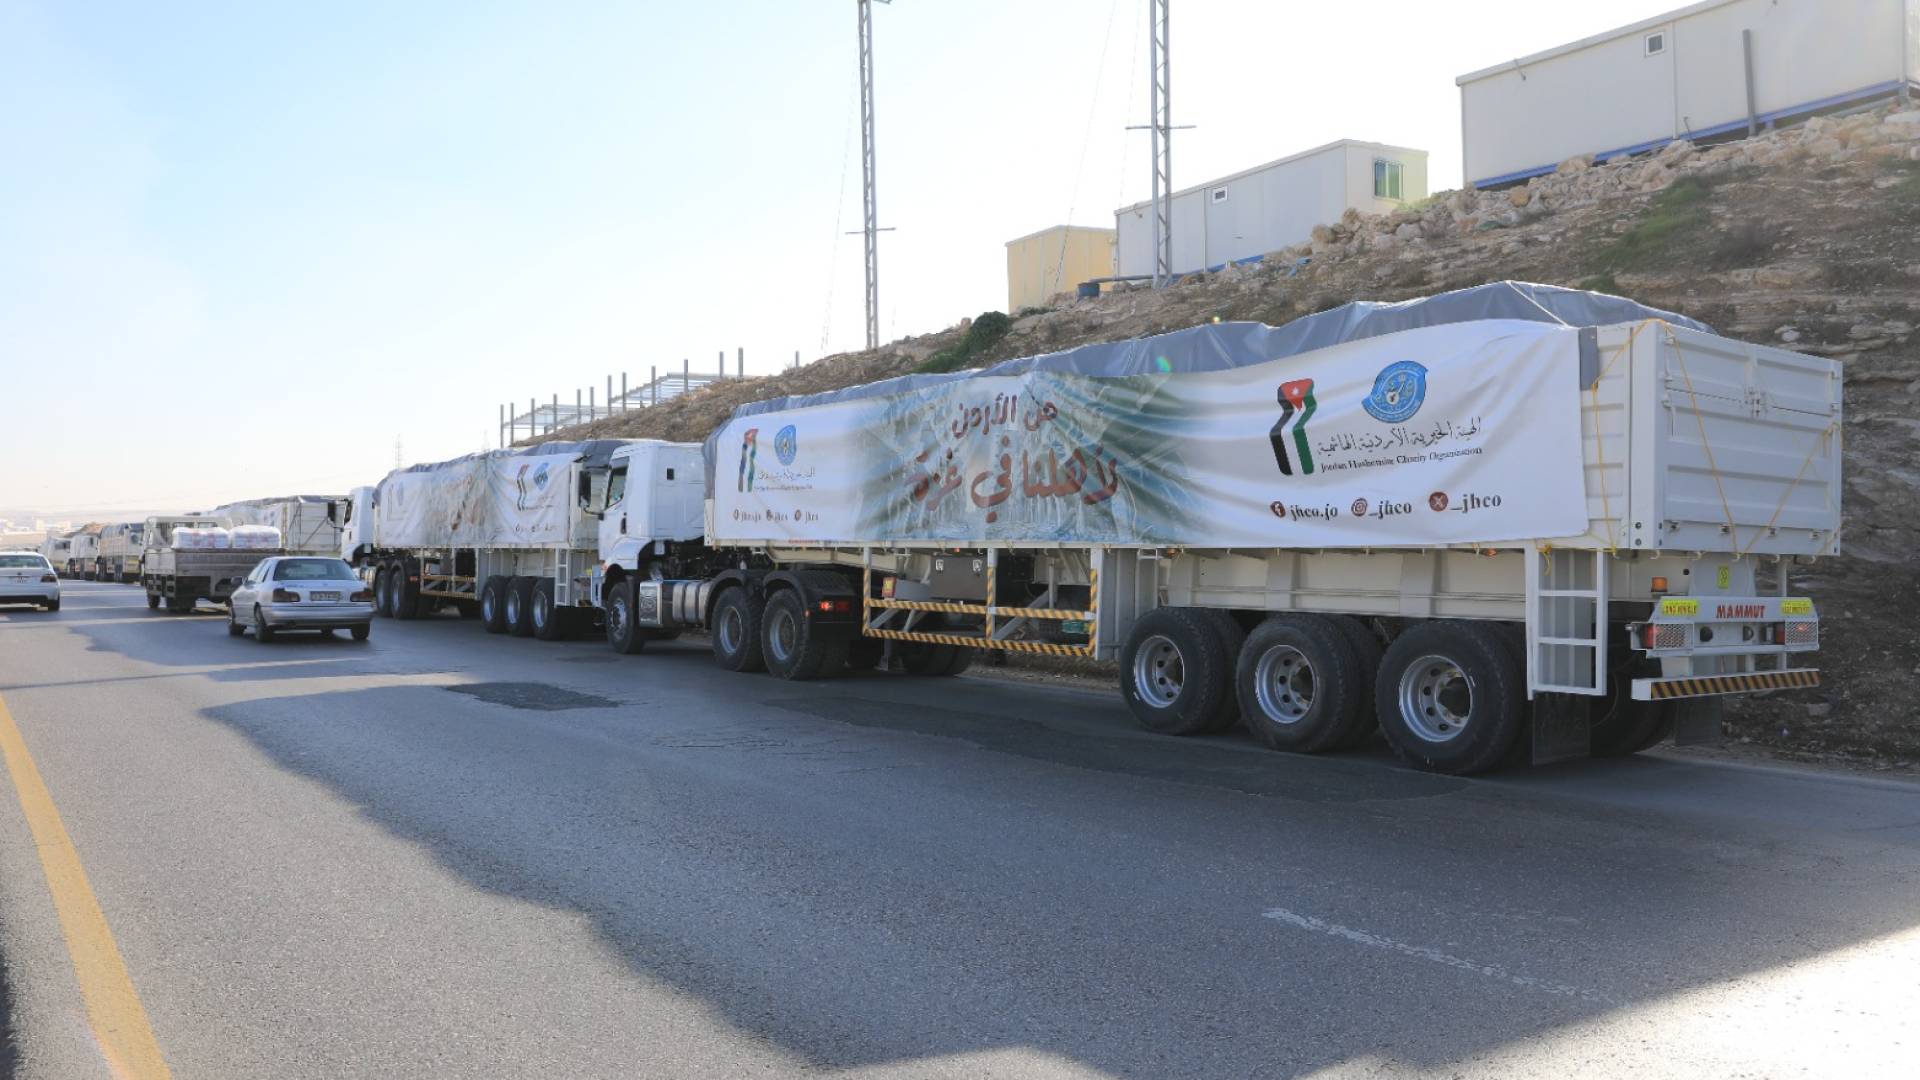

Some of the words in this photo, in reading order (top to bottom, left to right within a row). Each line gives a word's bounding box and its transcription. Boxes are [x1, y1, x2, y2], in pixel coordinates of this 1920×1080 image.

[952, 394, 1017, 439] الأردن
[1412, 420, 1453, 447] الخيرية
[1321, 461, 1347, 473] Jordan
[1396, 454, 1426, 465] Charity
[971, 435, 1012, 524] في
[1290, 503, 1338, 521] jhco.jo
[1368, 500, 1413, 519] _jhco
[1450, 493, 1502, 514] _jhco
[1716, 604, 1766, 619] MAMMUT
